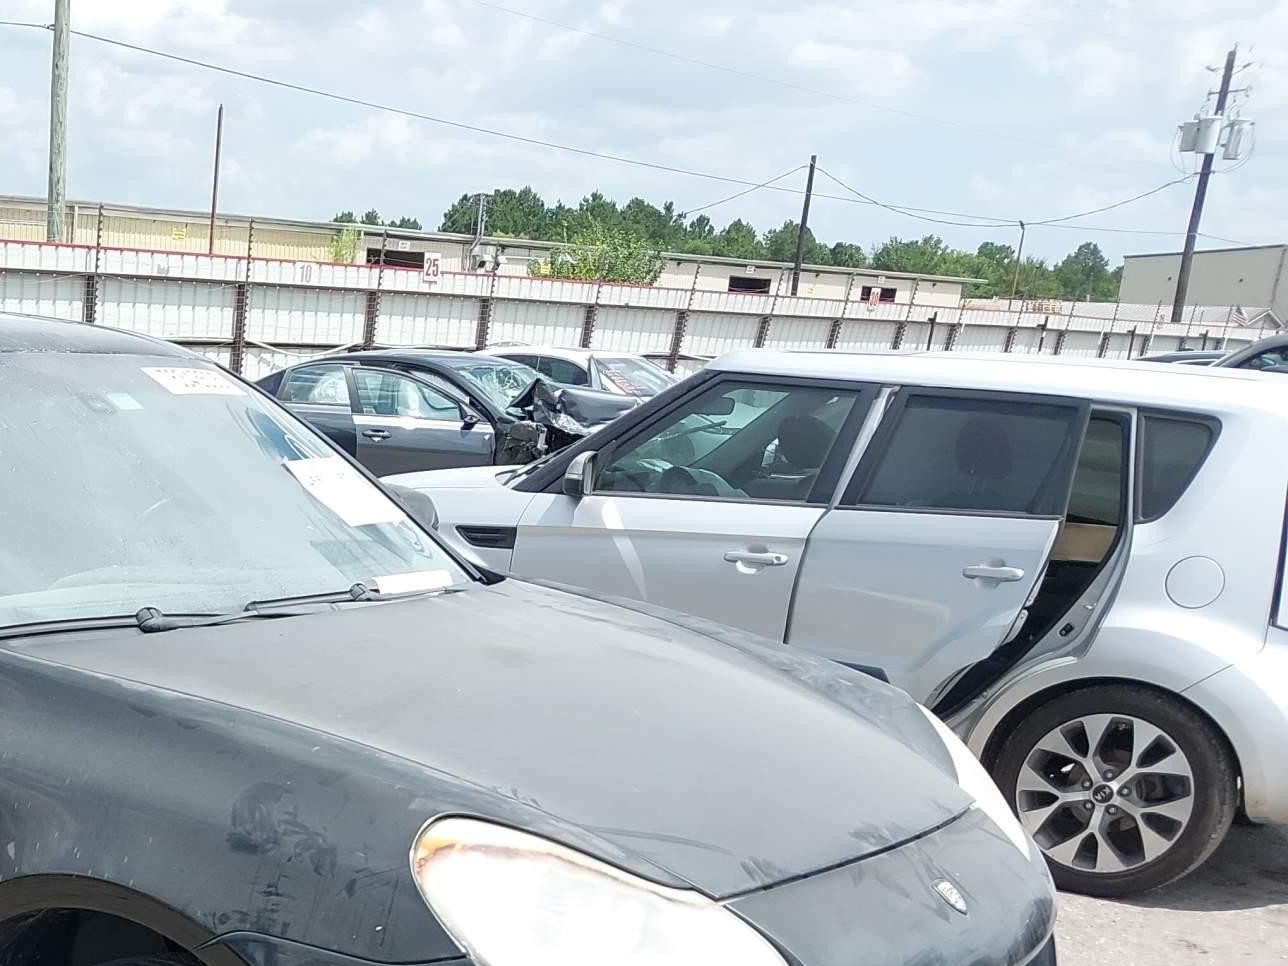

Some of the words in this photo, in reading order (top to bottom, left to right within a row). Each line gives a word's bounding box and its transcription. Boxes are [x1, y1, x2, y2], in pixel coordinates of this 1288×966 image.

[299, 263, 312, 283] 10
[426, 257, 439, 277] 25
[1095, 787, 1111, 800] KIA
